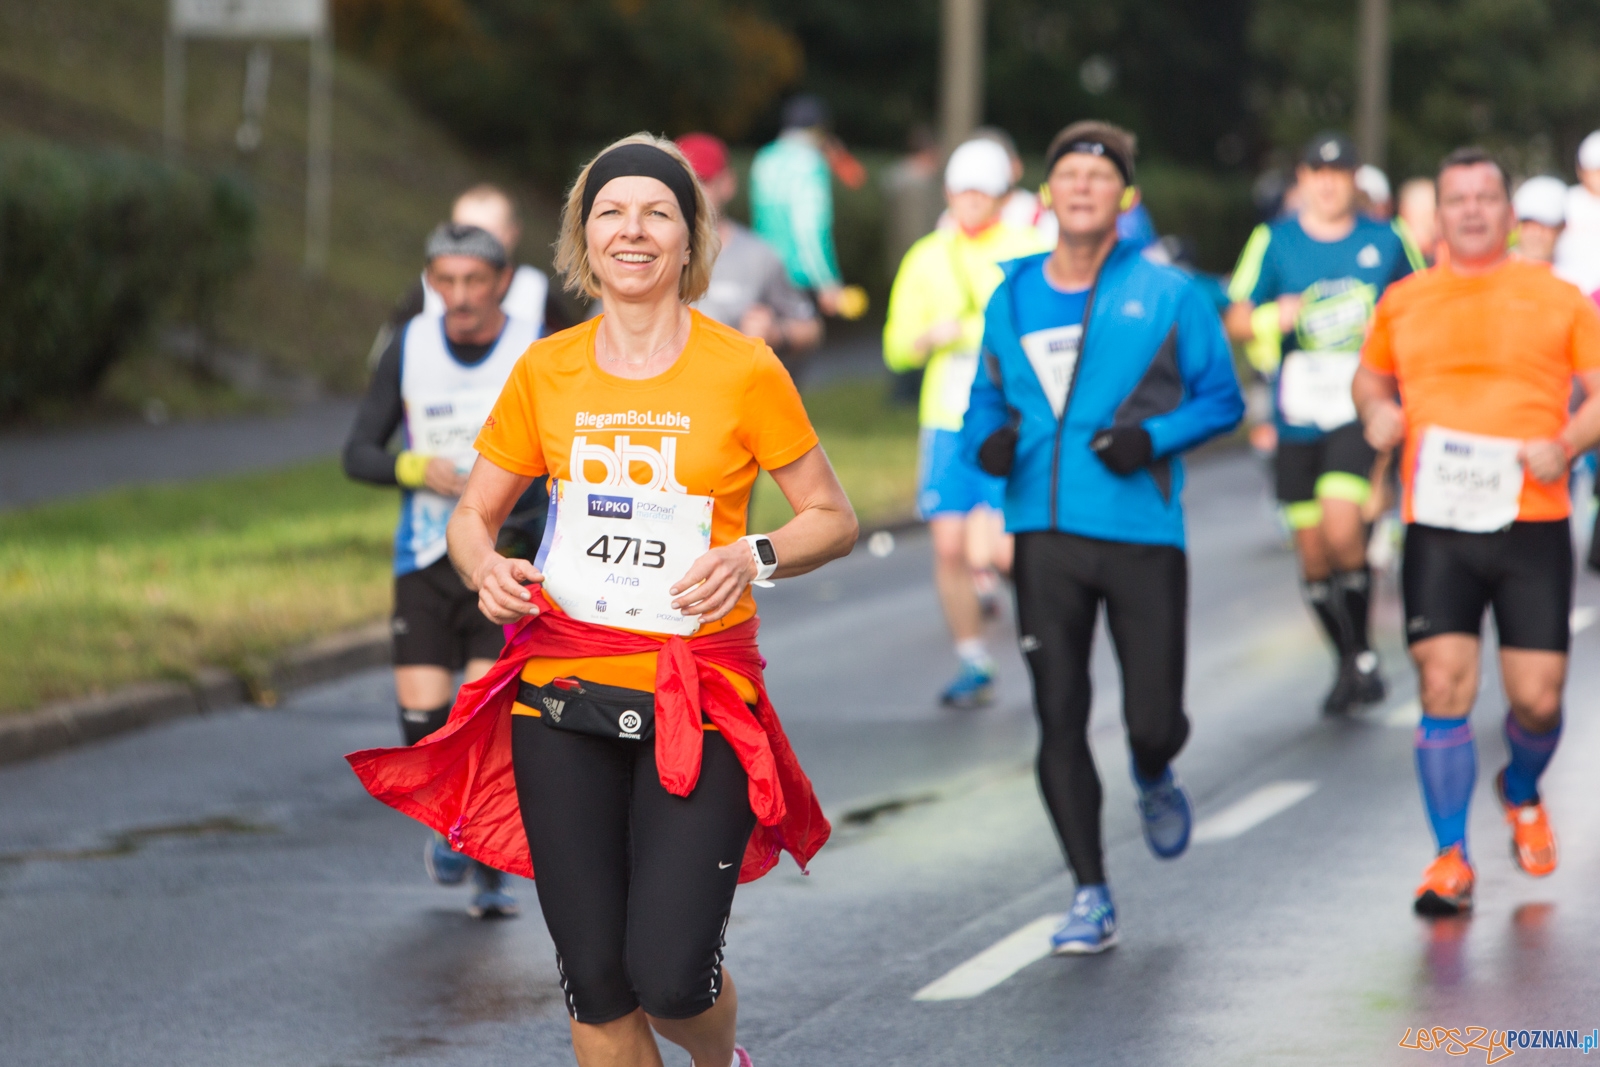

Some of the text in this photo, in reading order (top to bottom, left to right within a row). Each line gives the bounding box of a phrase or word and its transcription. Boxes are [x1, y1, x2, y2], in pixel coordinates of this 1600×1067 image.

[575, 409, 691, 430] BiegamBoLubię
[605, 501, 630, 514] PKO
[636, 509, 675, 521] maraton
[586, 534, 667, 569] 4713
[604, 572, 640, 587] Anna
[625, 607, 643, 617] 4F
[542, 696, 562, 723] adidas
[623, 715, 637, 728] PZU
[618, 731, 641, 740] ZDROWIE
